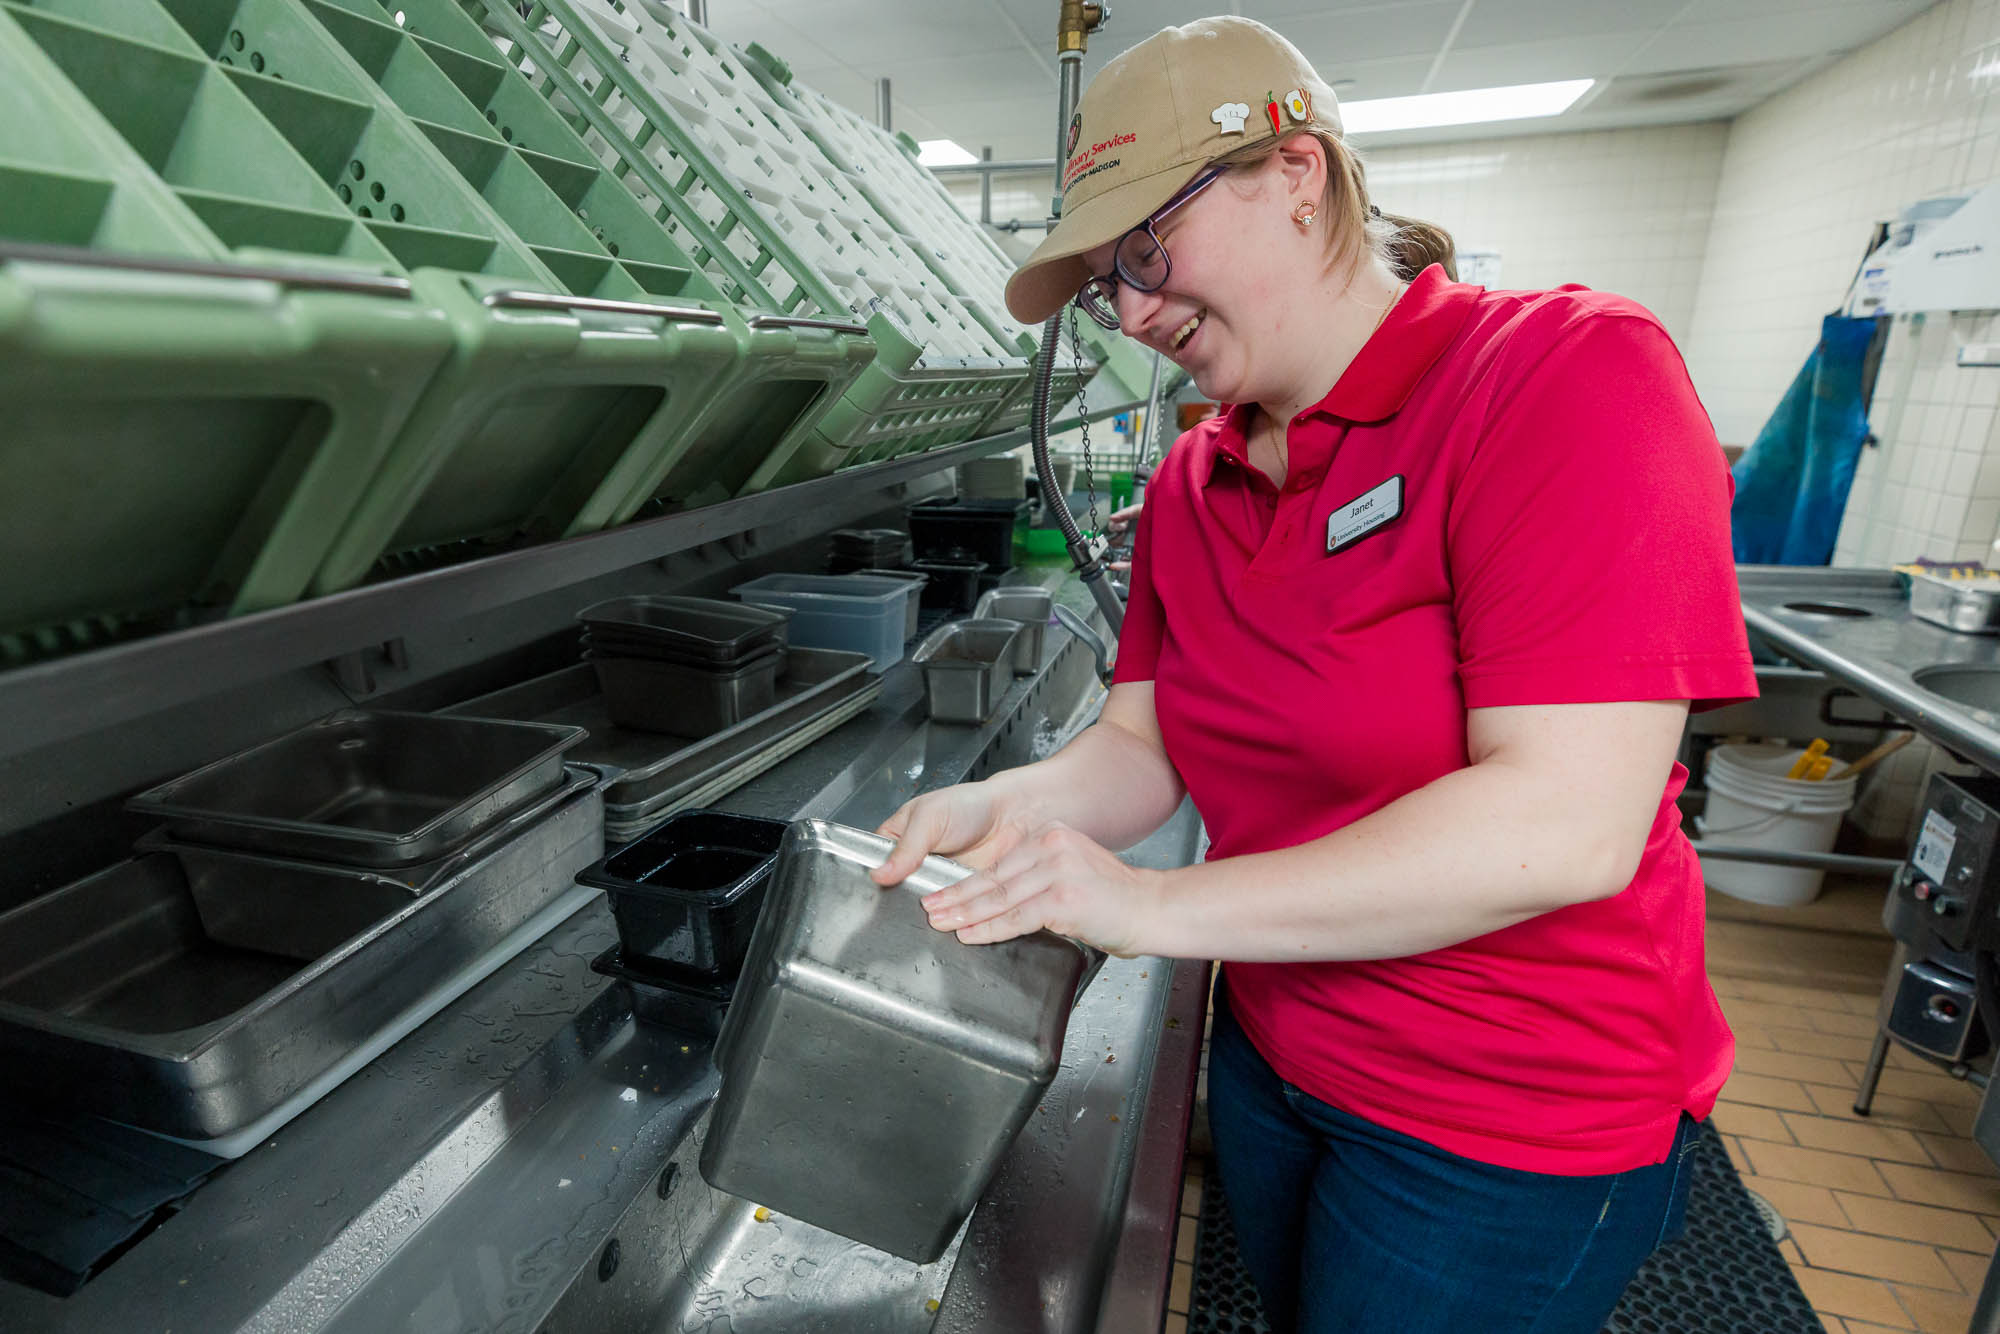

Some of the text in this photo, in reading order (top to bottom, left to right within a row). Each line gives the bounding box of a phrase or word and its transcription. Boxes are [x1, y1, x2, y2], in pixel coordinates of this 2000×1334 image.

[1064, 149, 1090, 179] linary
[1091, 133, 1136, 155] Services
[1065, 159, 1120, 193] CONSIN-MADISON
[1350, 498, 1374, 519] Janet
[1337, 512, 1385, 541] University Housing
